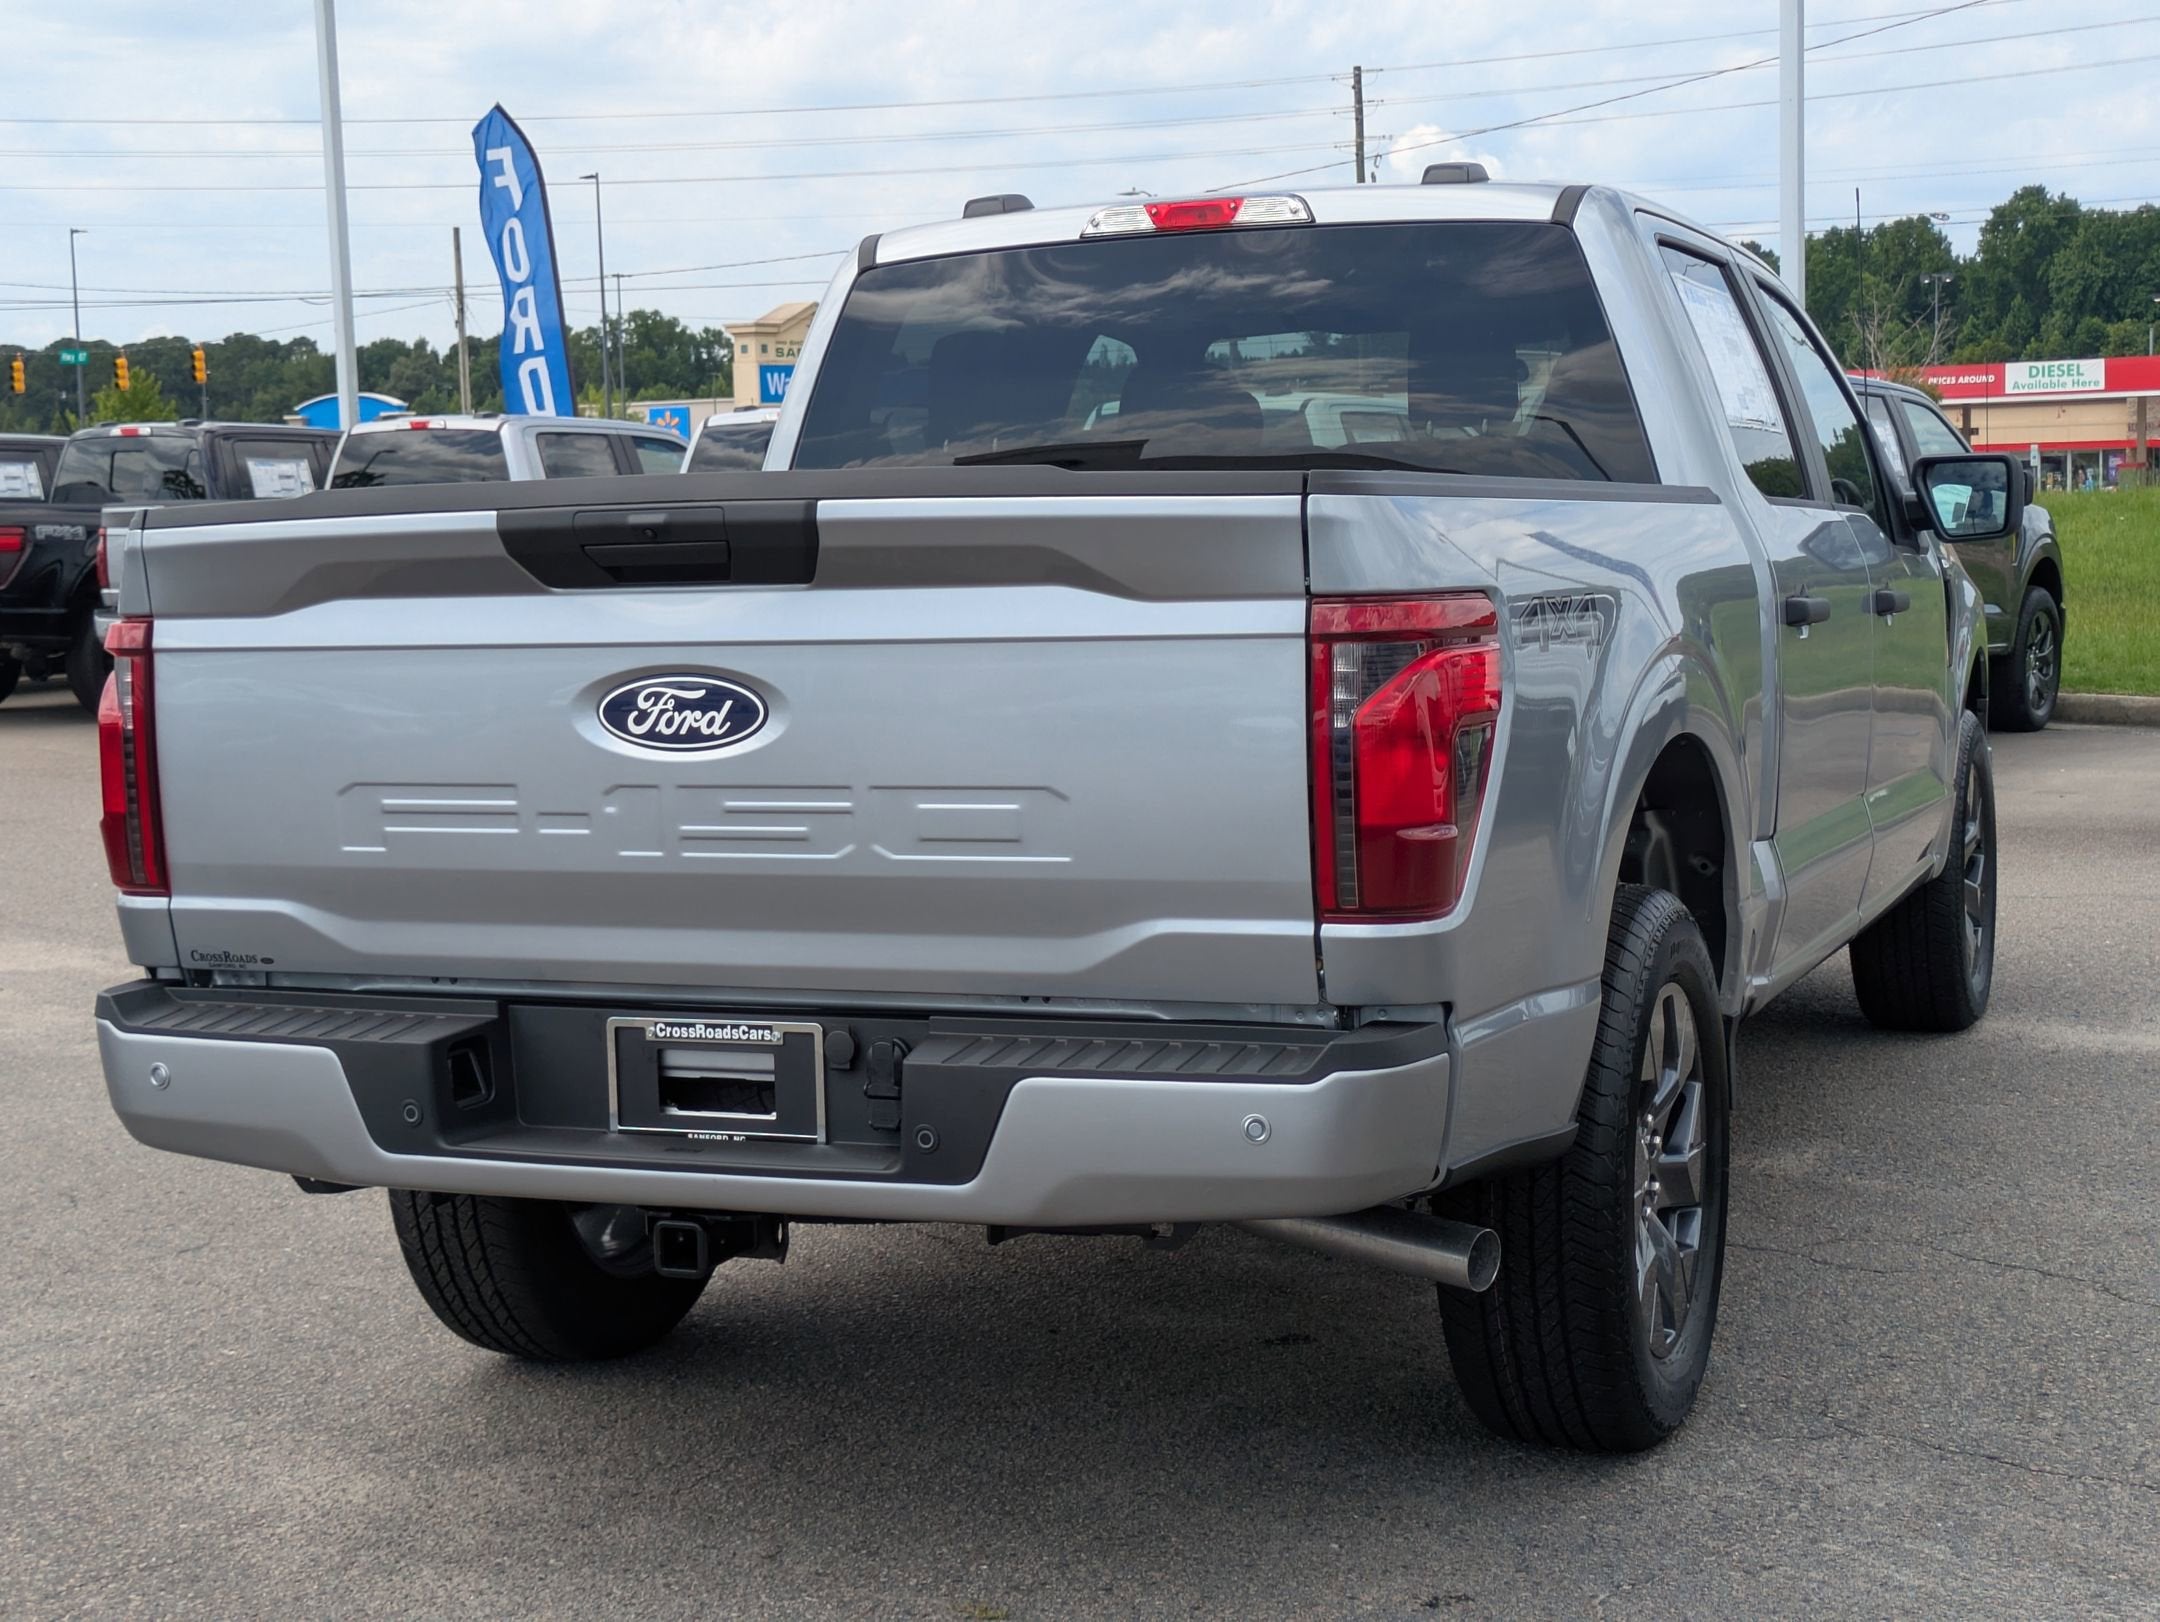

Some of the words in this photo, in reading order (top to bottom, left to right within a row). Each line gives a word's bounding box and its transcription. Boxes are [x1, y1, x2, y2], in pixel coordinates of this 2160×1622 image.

[1927, 376, 1956, 385] PRICES
[1957, 374, 1996, 384] AROUND
[2028, 363, 2085, 379] DIESEL
[2012, 378, 2068, 391] Available
[2071, 378, 2100, 388] Here
[627, 687, 734, 736] Ford
[338, 781, 1073, 863] F-150
[655, 1022, 772, 1041] CrossRoadsCars
